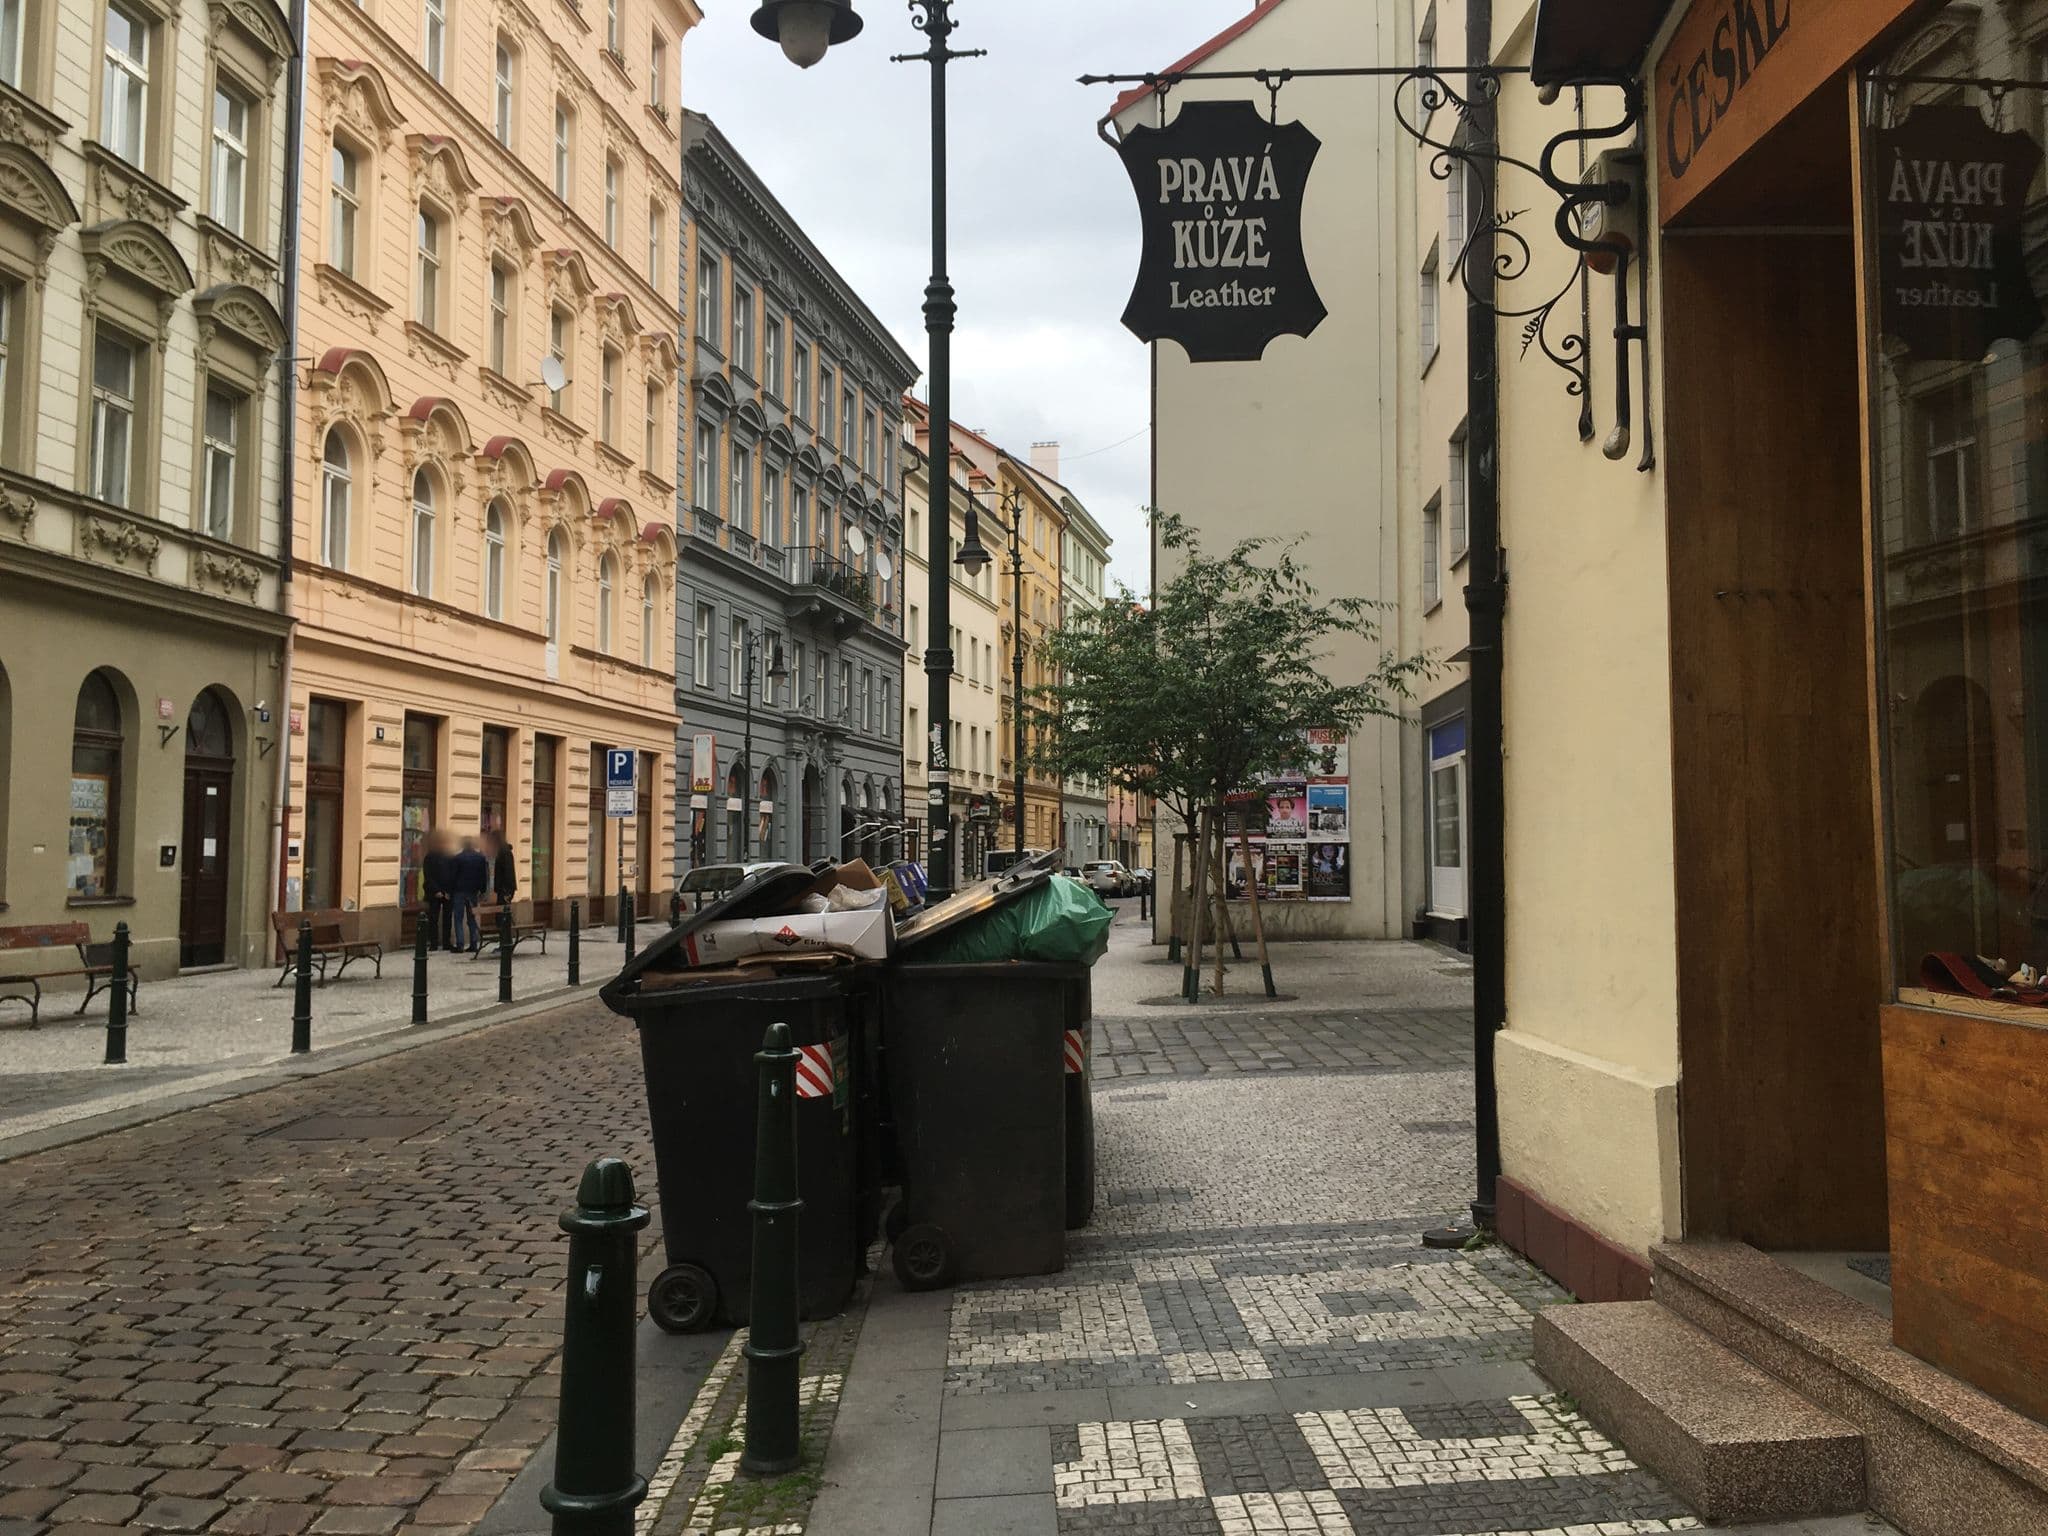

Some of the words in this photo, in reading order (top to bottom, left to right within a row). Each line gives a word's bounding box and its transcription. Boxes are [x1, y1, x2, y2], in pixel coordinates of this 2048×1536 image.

[1157, 142, 1281, 204] PRAVÁ
[1171, 204, 1271, 269] KŮŽE
[1169, 279, 1276, 309] Leather
[614, 752, 627, 774] P
